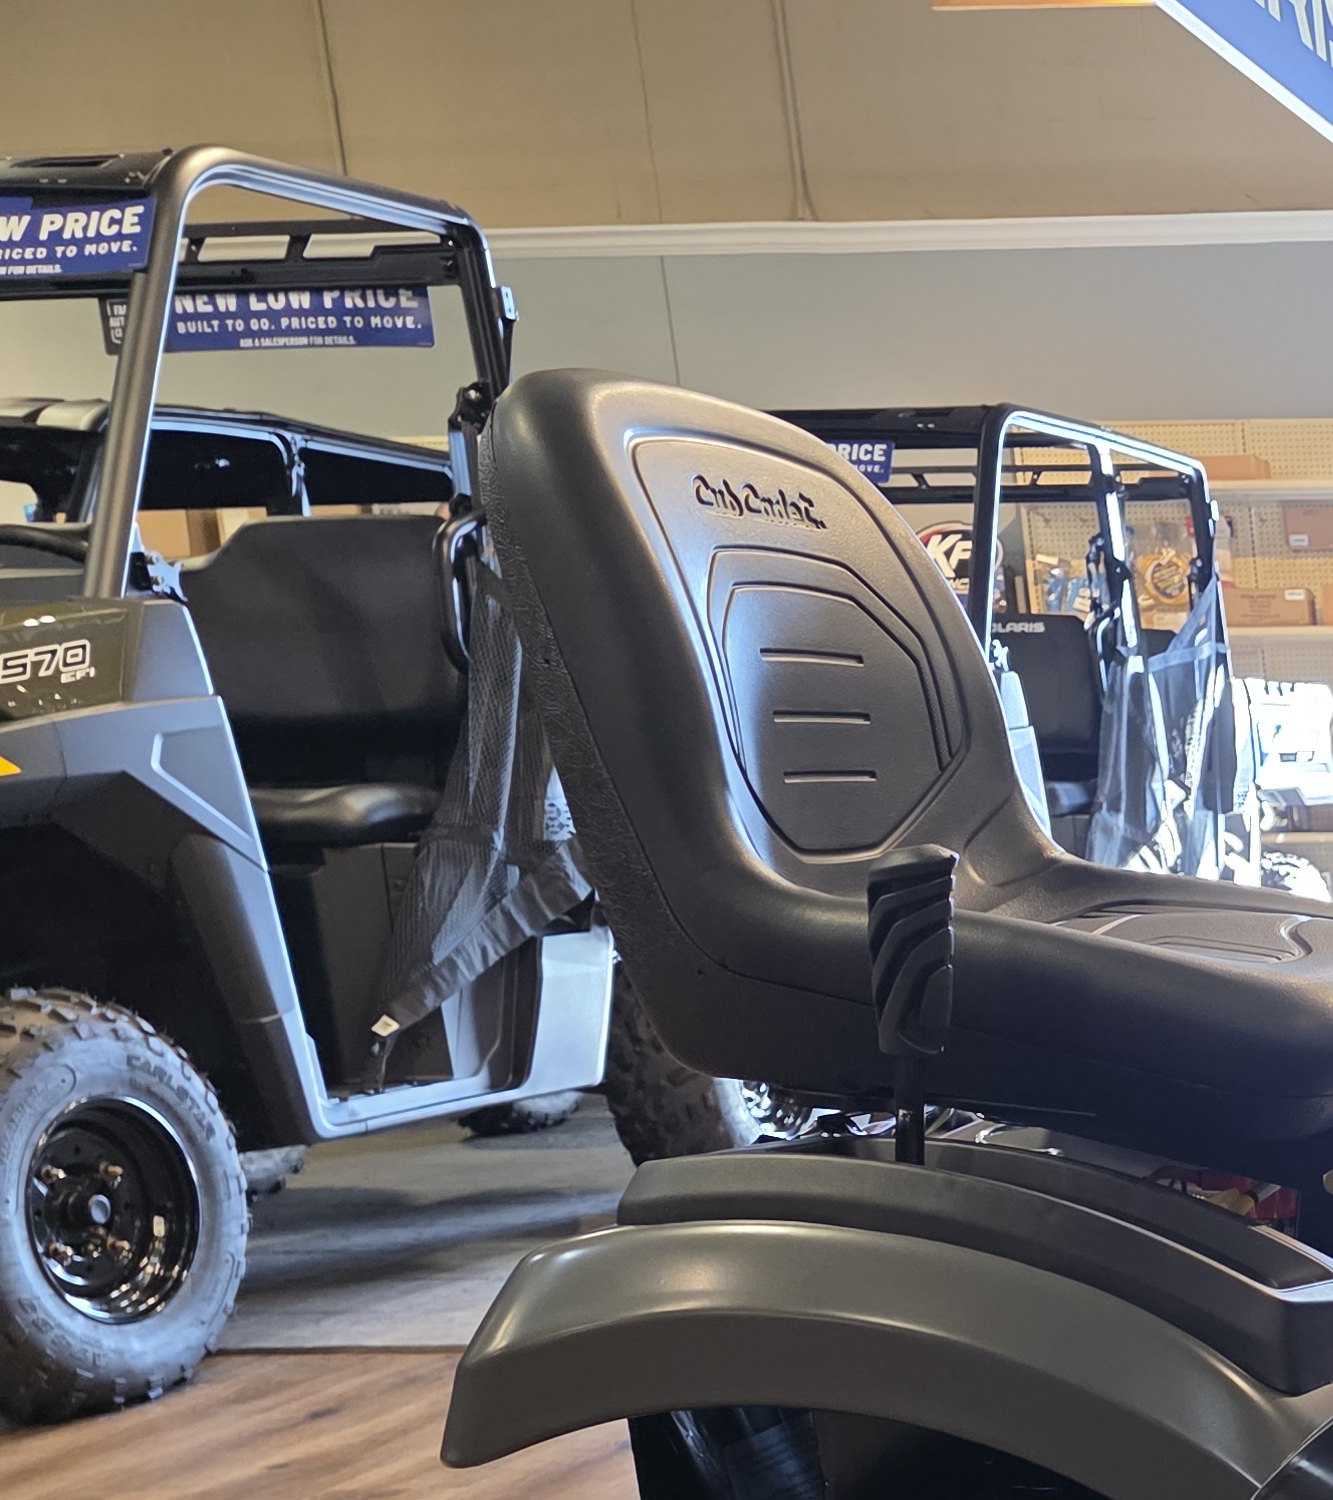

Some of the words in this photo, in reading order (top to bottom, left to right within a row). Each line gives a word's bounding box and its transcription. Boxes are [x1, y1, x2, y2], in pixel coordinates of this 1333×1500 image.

[39, 205, 145, 241] PRICE
[55, 245, 78, 258] TO
[84, 240, 138, 256] MOVE.
[174, 293, 237, 314] NEW
[249, 291, 310, 311] LOW
[323, 289, 418, 309] PRICE
[176, 320, 219, 334] BUILT
[225, 319, 244, 332] TO
[281, 316, 337, 329] PRICED
[343, 316, 364, 328] TO
[370, 315, 422, 329] MOVE.
[0, 639, 90, 684] 570
